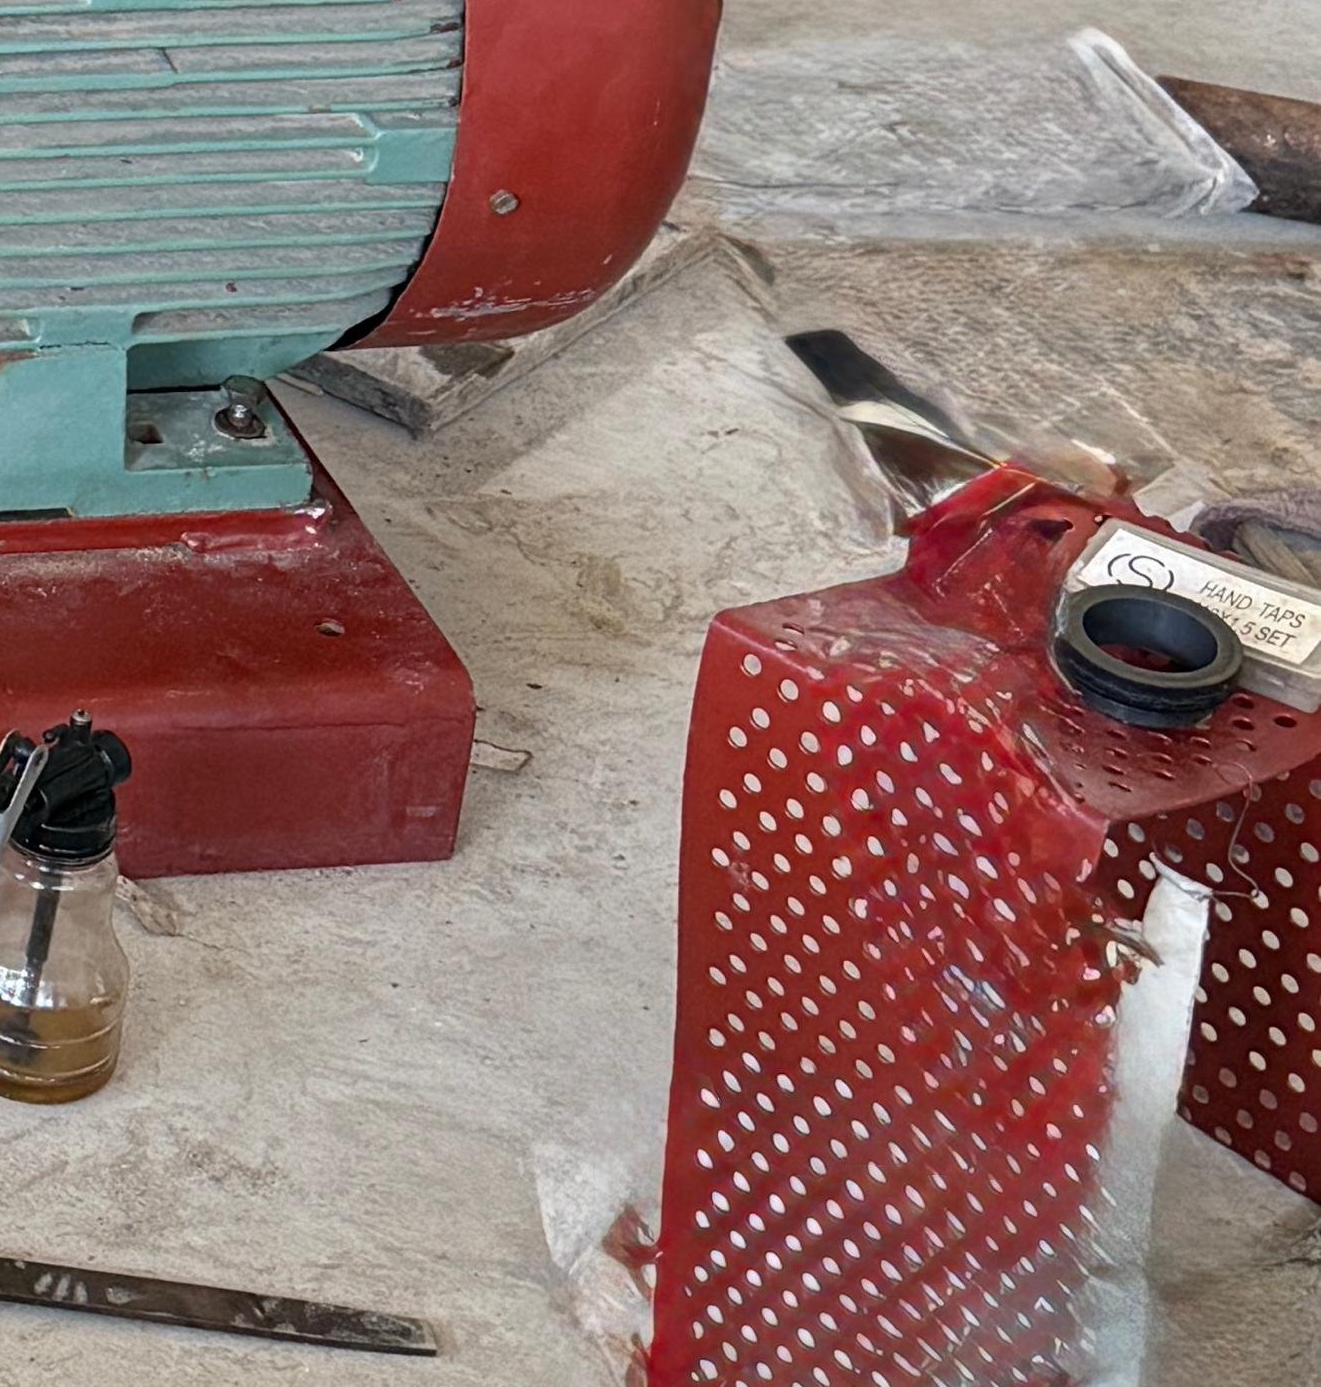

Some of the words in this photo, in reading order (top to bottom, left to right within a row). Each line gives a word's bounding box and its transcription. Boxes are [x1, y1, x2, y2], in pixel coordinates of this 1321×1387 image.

[1200, 580, 1253, 610] HAND
[1259, 602, 1306, 629] TAPS
[1254, 626, 1297, 648] SET
